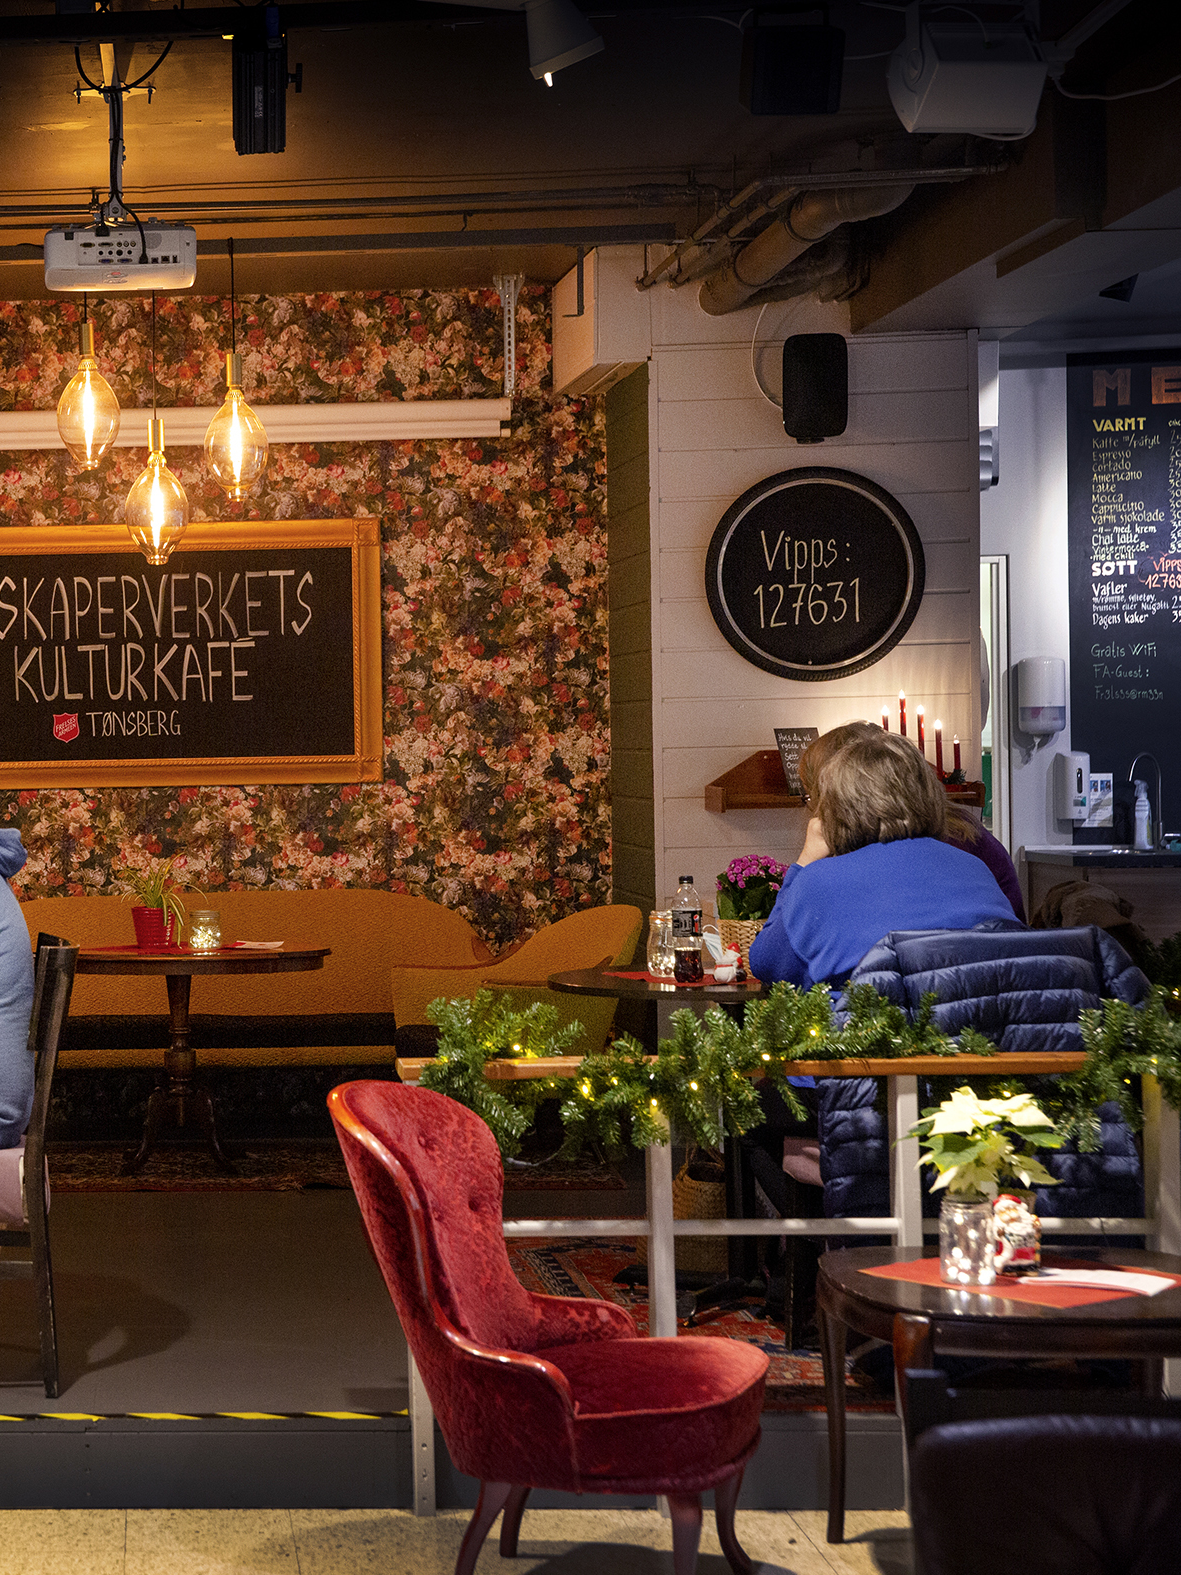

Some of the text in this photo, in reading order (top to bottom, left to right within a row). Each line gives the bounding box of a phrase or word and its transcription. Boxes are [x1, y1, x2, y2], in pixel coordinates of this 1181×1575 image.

[1092, 417, 1147, 432] VARMT
[1092, 449, 1132, 464] Espresso
[1092, 459, 1132, 472] Cortado
[1092, 470, 1143, 483] Americano
[1092, 483, 1117, 493] Latte
[1091, 493, 1124, 504] Mocca
[1120, 508, 1166, 526] sjokolade
[1113, 523, 1132, 534] med
[1135, 523, 1157, 534] krem
[1091, 560, 1138, 577] SØTT
[1091, 580, 1128, 597] Vafler
[753, 577, 860, 629] 127631
[1092, 602, 1119, 612] brunost
[1092, 611, 1149, 630] Dagens kaker
[1090, 641, 1157, 659] Gratis WiFi
[14, 636, 257, 703] KULTURKAFÉ
[85, 709, 181, 737] TØNSBERG
